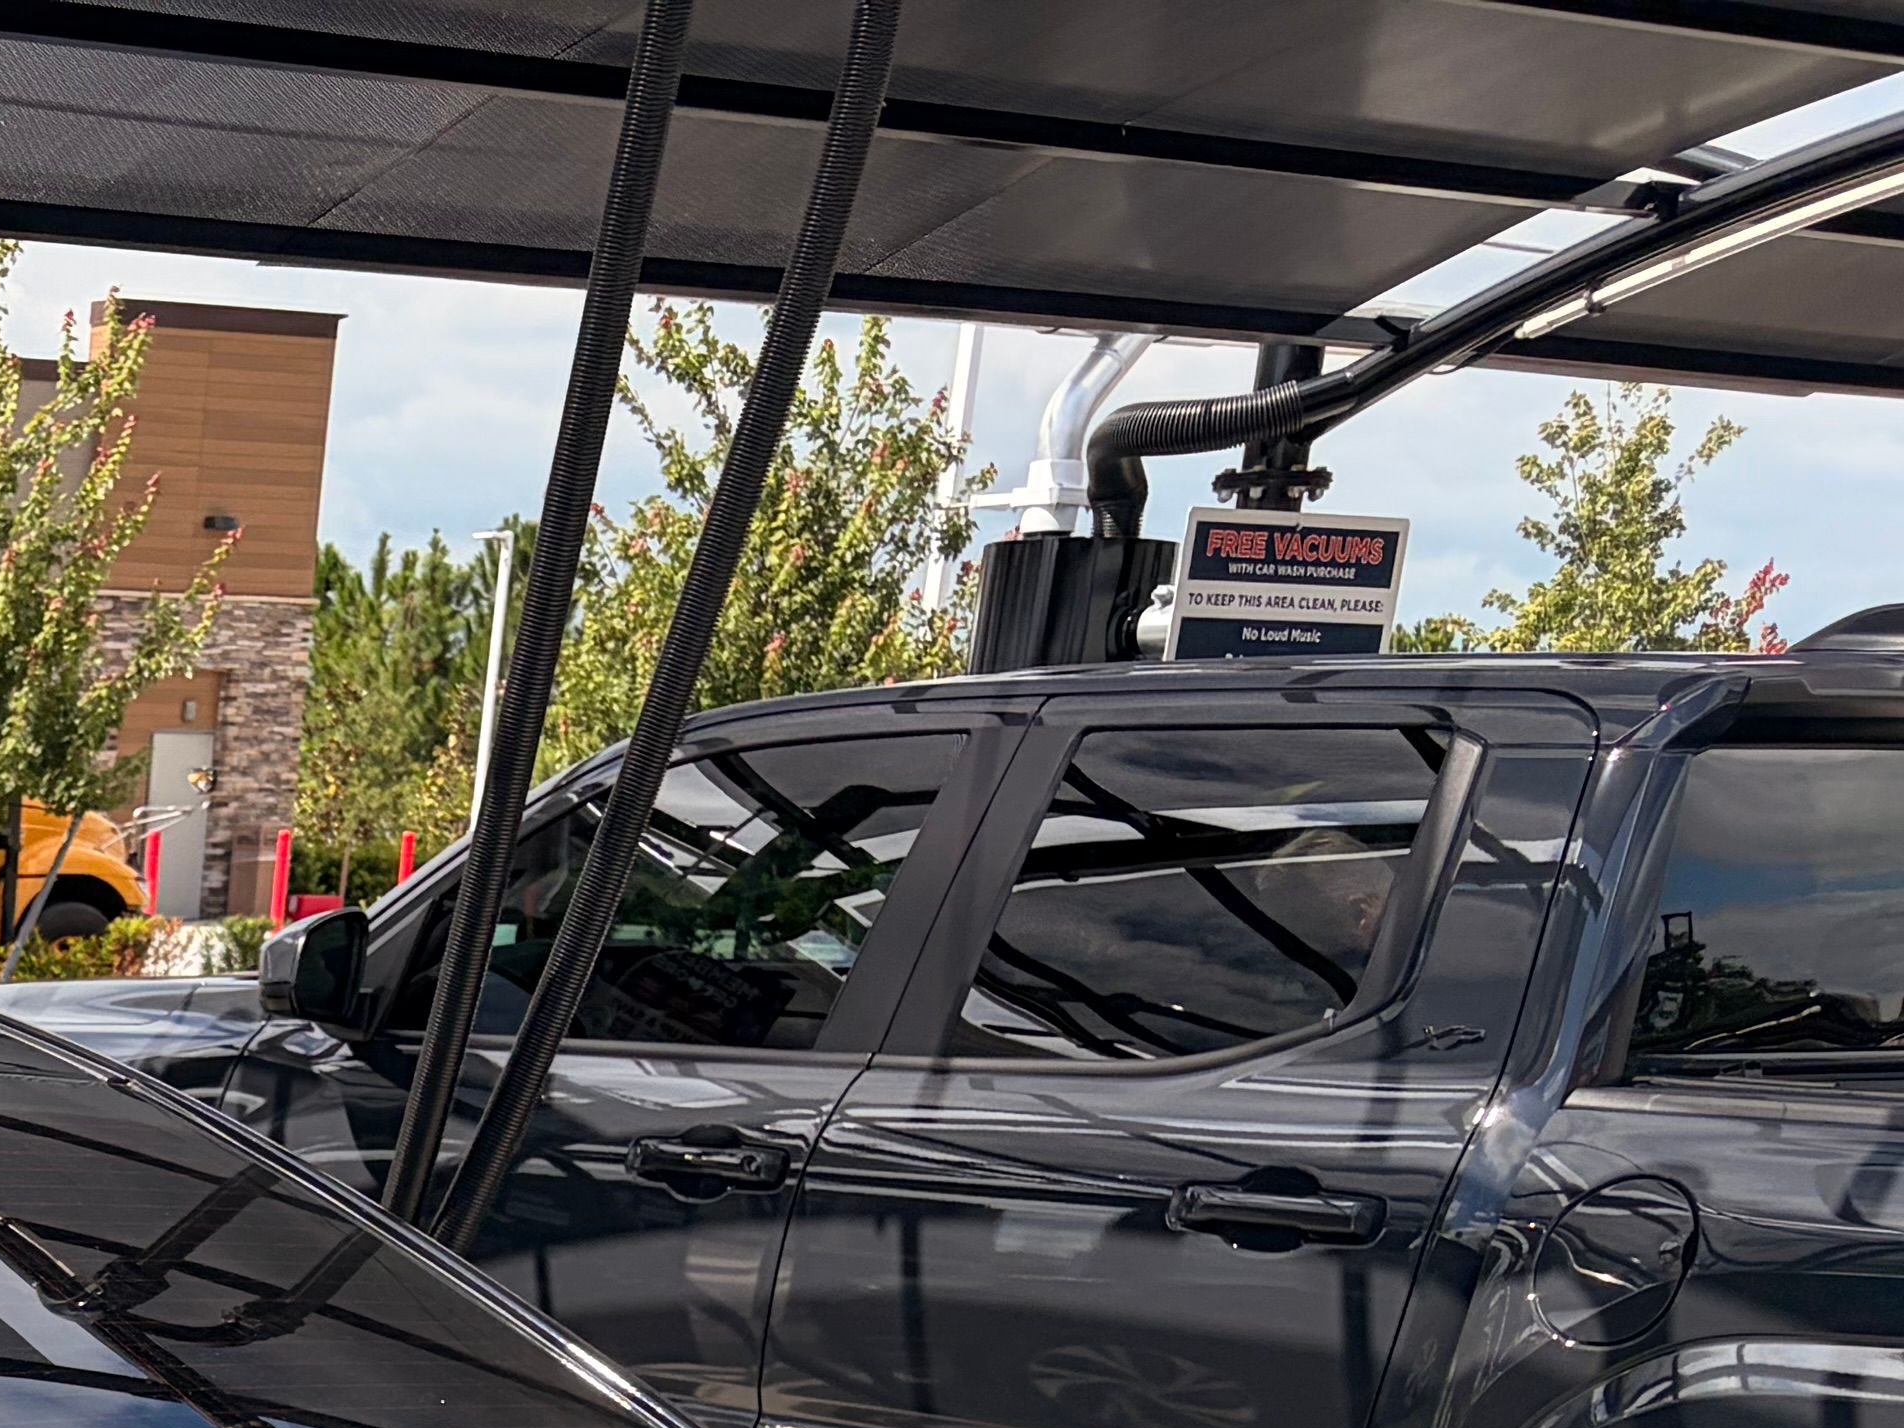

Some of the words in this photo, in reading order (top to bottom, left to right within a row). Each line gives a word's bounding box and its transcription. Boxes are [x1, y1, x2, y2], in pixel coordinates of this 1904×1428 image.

[1205, 529, 1269, 560] FREE
[1274, 532, 1385, 565] VACUUMS
[1228, 562, 1254, 574] WITH
[1255, 563, 1276, 576] CAR
[1277, 564, 1305, 577] WASH
[1306, 566, 1356, 580] PURCHASE
[1188, 593, 1204, 605] TO
[1206, 593, 1235, 607] KEEP
[1237, 594, 1263, 608] THIS
[1264, 596, 1295, 609] AREA
[1298, 597, 1337, 613] CLEAN,
[1339, 598, 1384, 613] PLEASE:
[1242, 626, 1258, 641] No
[1260, 627, 1289, 642] Loud
[1291, 629, 1322, 643] Music
